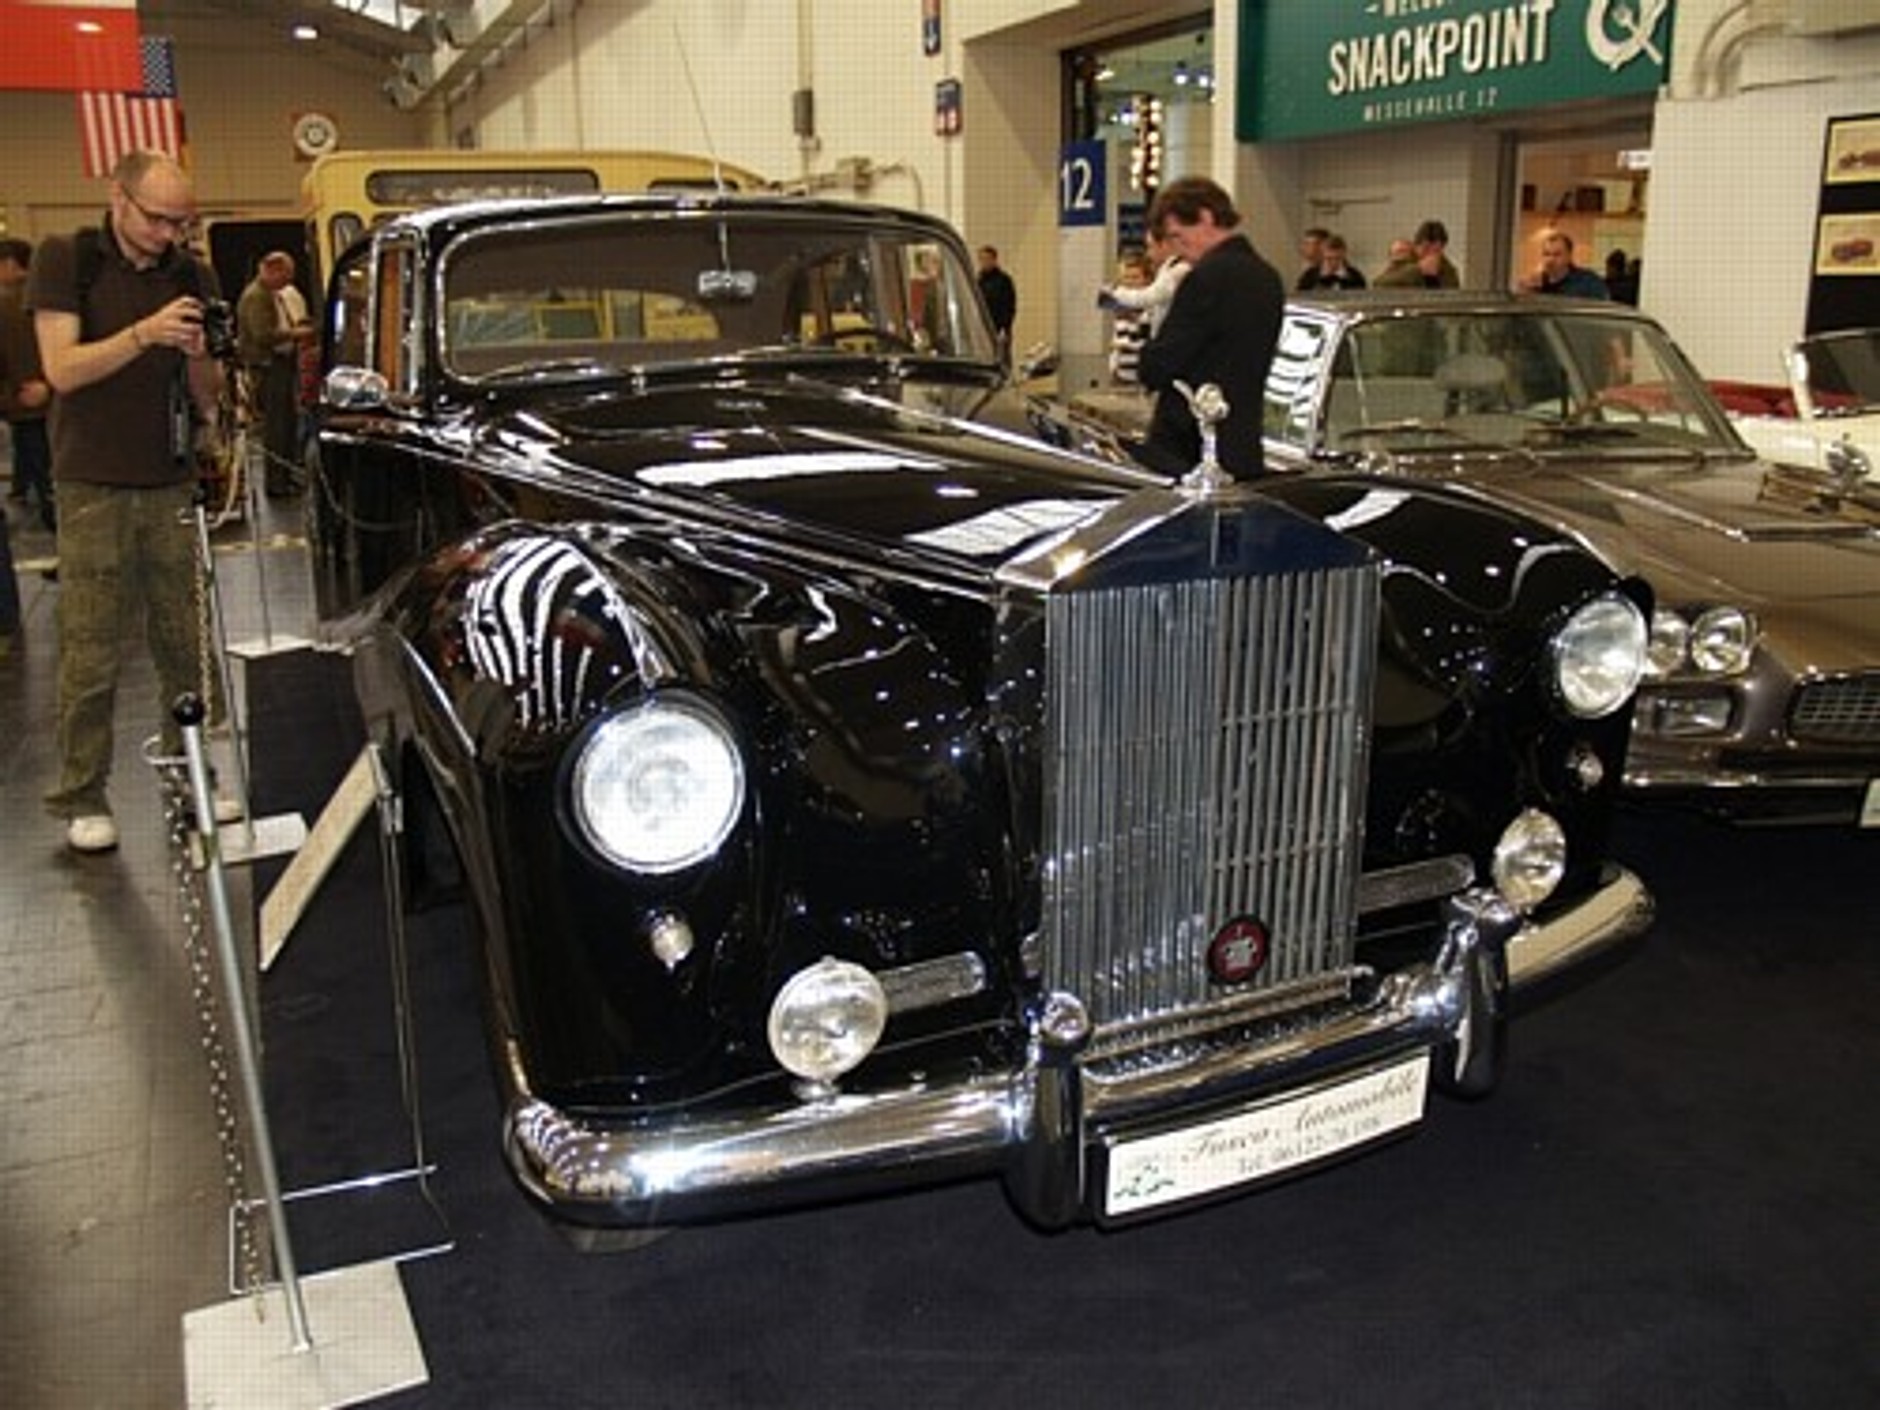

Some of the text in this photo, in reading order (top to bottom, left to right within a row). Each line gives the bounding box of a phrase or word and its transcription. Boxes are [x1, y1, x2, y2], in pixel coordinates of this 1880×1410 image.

[1327, 1, 1555, 96] SNACKPOINT
[1364, 89, 1467, 121] MESSEHALLE
[1060, 157, 1094, 211] 12
